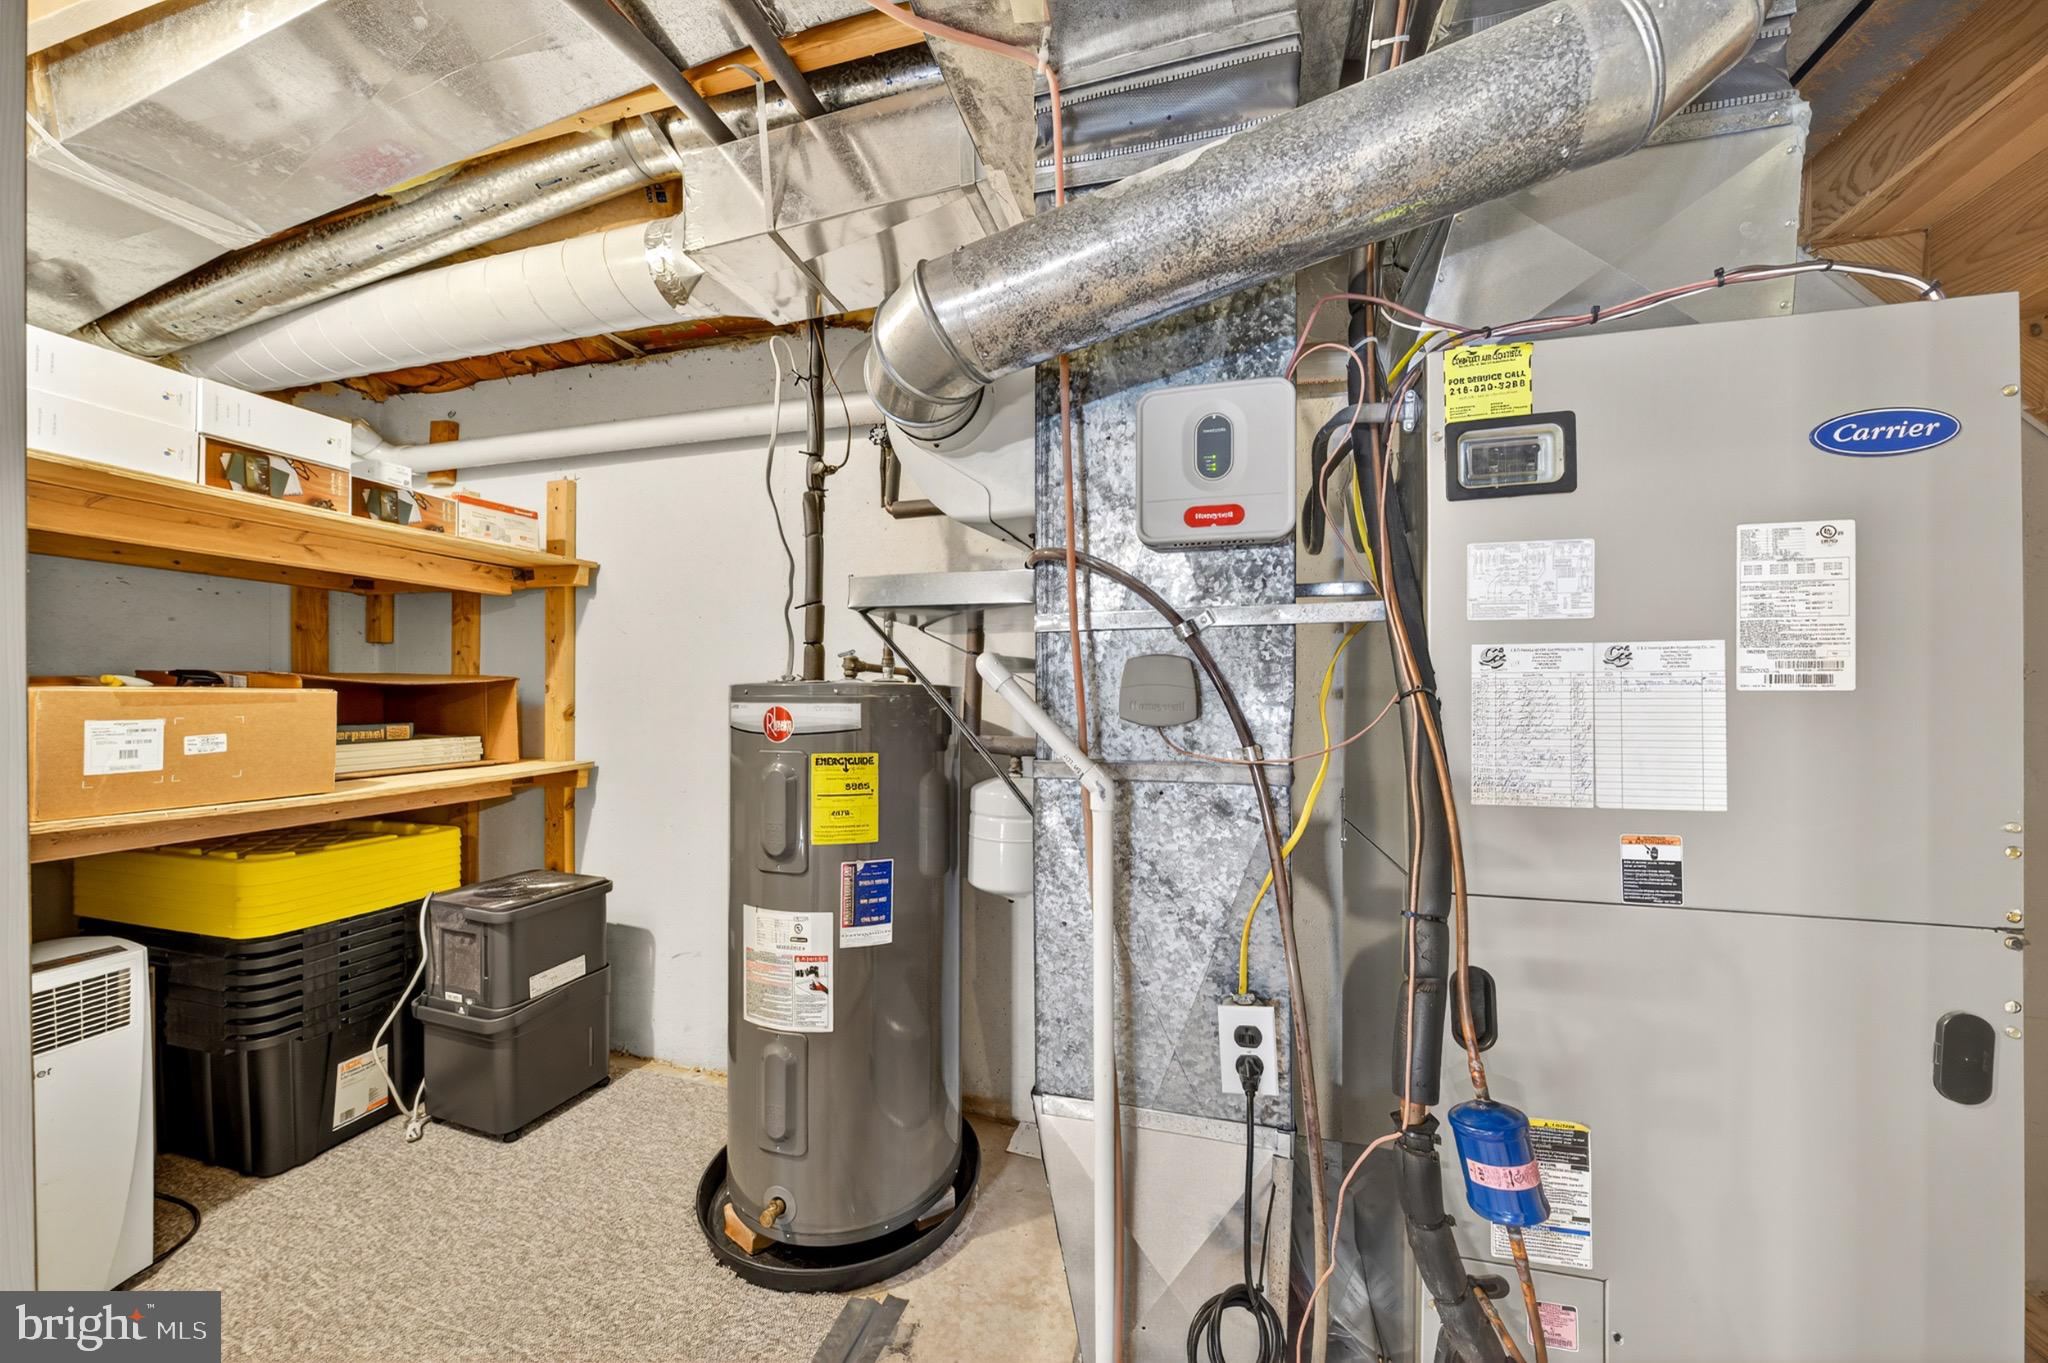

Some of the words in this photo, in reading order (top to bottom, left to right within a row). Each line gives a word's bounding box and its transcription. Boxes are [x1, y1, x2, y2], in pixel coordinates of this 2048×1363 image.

[1449, 377, 1465, 386] FOR
[1467, 373, 1502, 384] SERVICE
[1504, 370, 1526, 379] CALL
[1833, 420, 1941, 443] Carrier
[1195, 511, 1234, 520] Honeywell
[1129, 700, 1185, 713] Honeywell
[766, 706, 793, 737] Rheem
